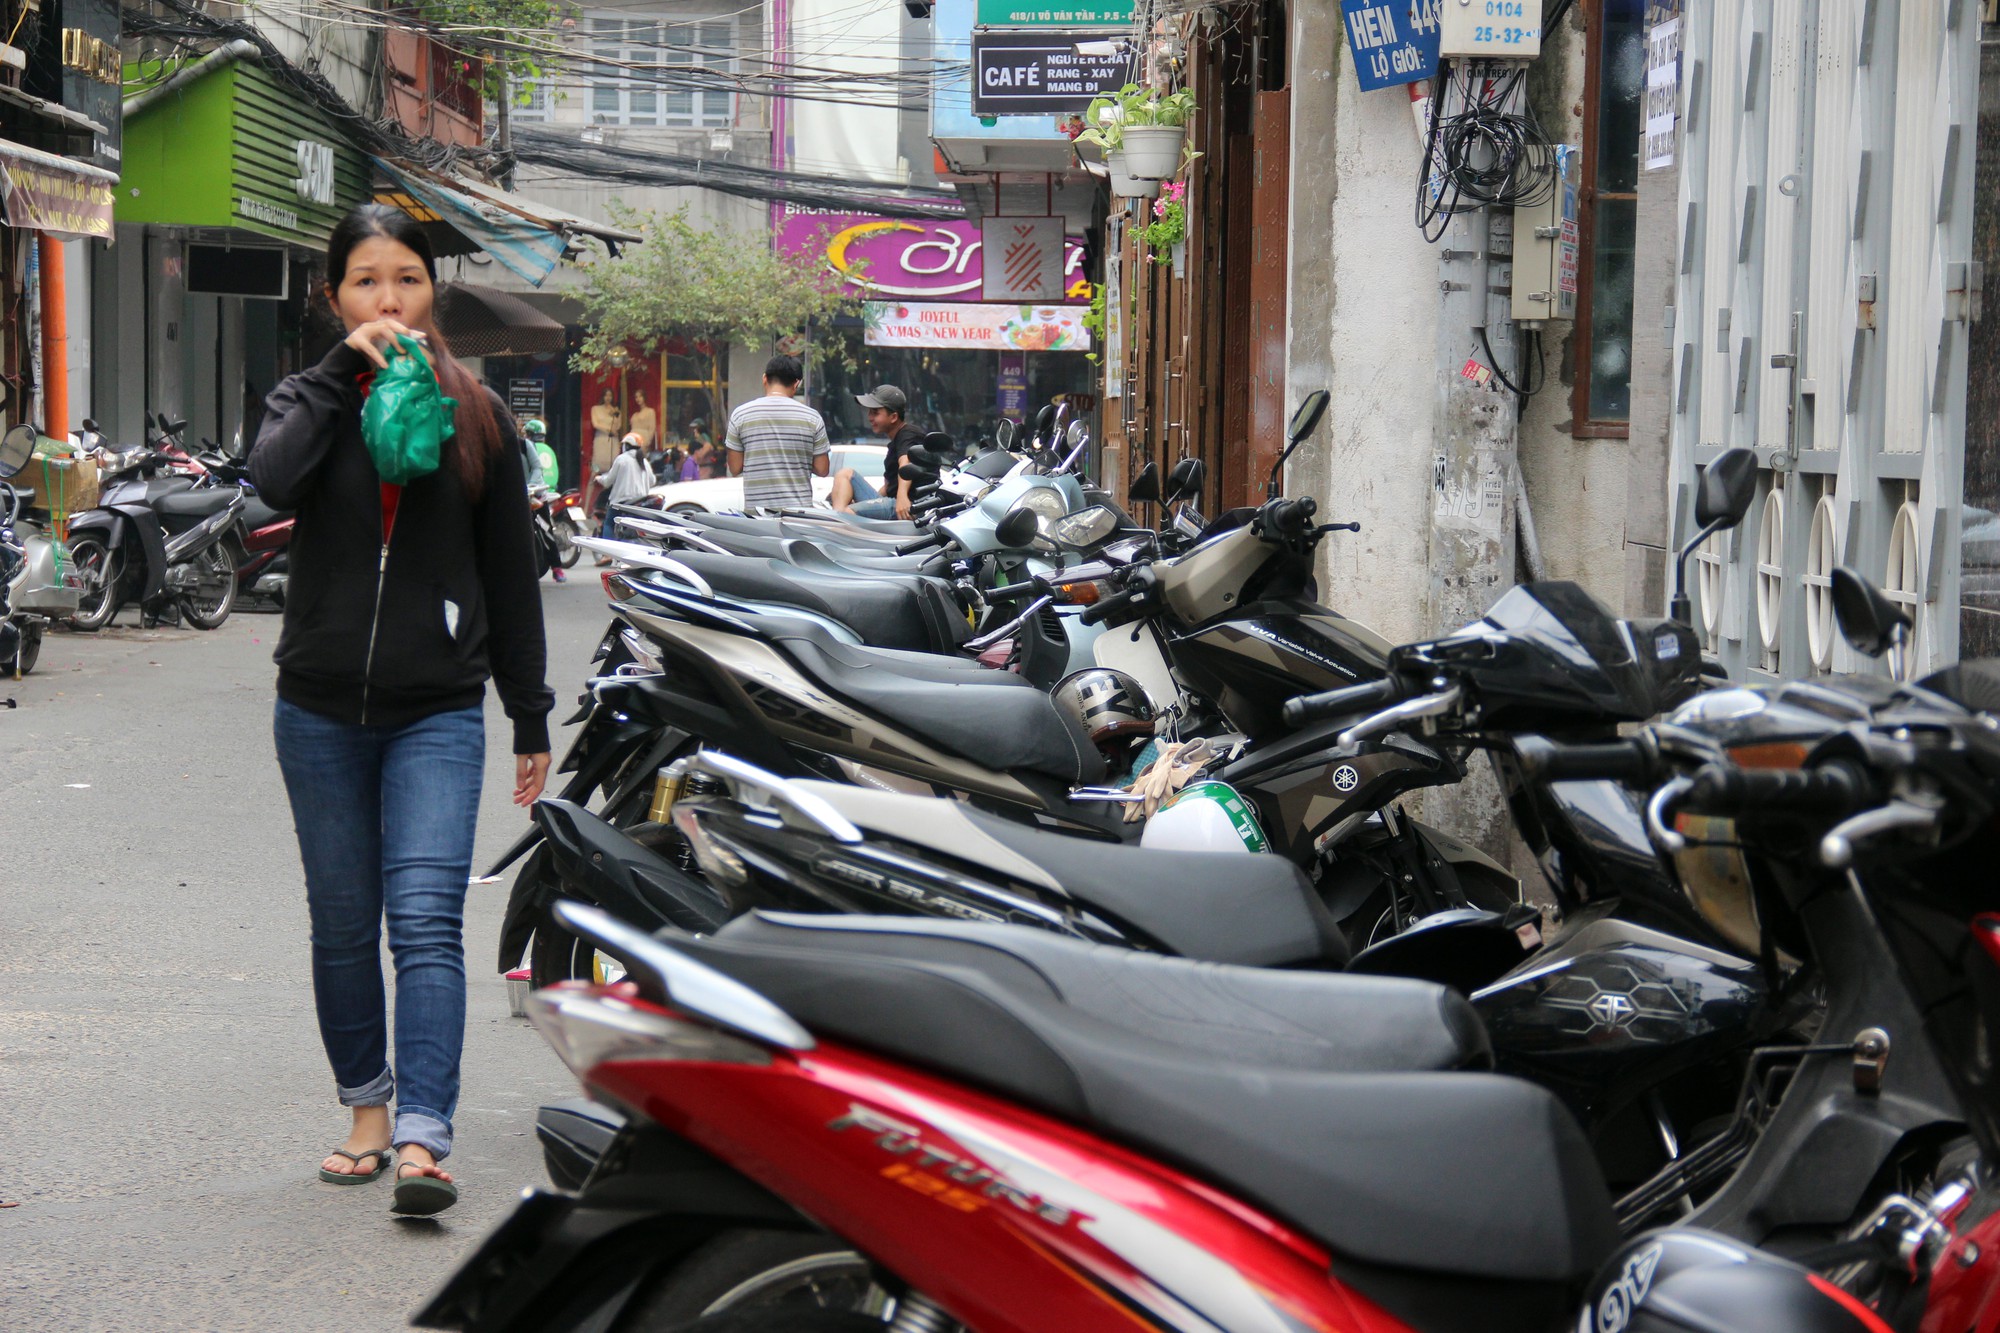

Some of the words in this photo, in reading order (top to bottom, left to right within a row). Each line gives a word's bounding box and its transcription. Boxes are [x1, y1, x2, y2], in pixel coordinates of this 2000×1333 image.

[1038, 11, 1051, 21] VÕ
[1054, 10, 1073, 21] VĂN
[1075, 8, 1096, 21] TẦN
[1104, 11, 1120, 21] P.5
[1486, 1, 1523, 17] 0104
[1349, 0, 1398, 50] HẺM
[1370, 48, 1390, 80] LỘ
[985, 62, 1040, 86] CAFÉ
[1047, 68, 1081, 79] RANG
[1090, 68, 1116, 79] XAY
[1047, 82, 1083, 92] MANG
[1085, 82, 1099, 92] ĐI
[919, 310, 960, 324] JOYFUL
[886, 325, 921, 338] X'MAS
[932, 327, 959, 339] NEW
[962, 327, 991, 340] YEAR
[1003, 366, 1020, 377] 449
[1277, 636, 1305, 652] Variable
[1305, 648, 1324, 662] Valve
[1323, 658, 1357, 678] Actuation
[826, 1101, 1072, 1227] FUTURE
